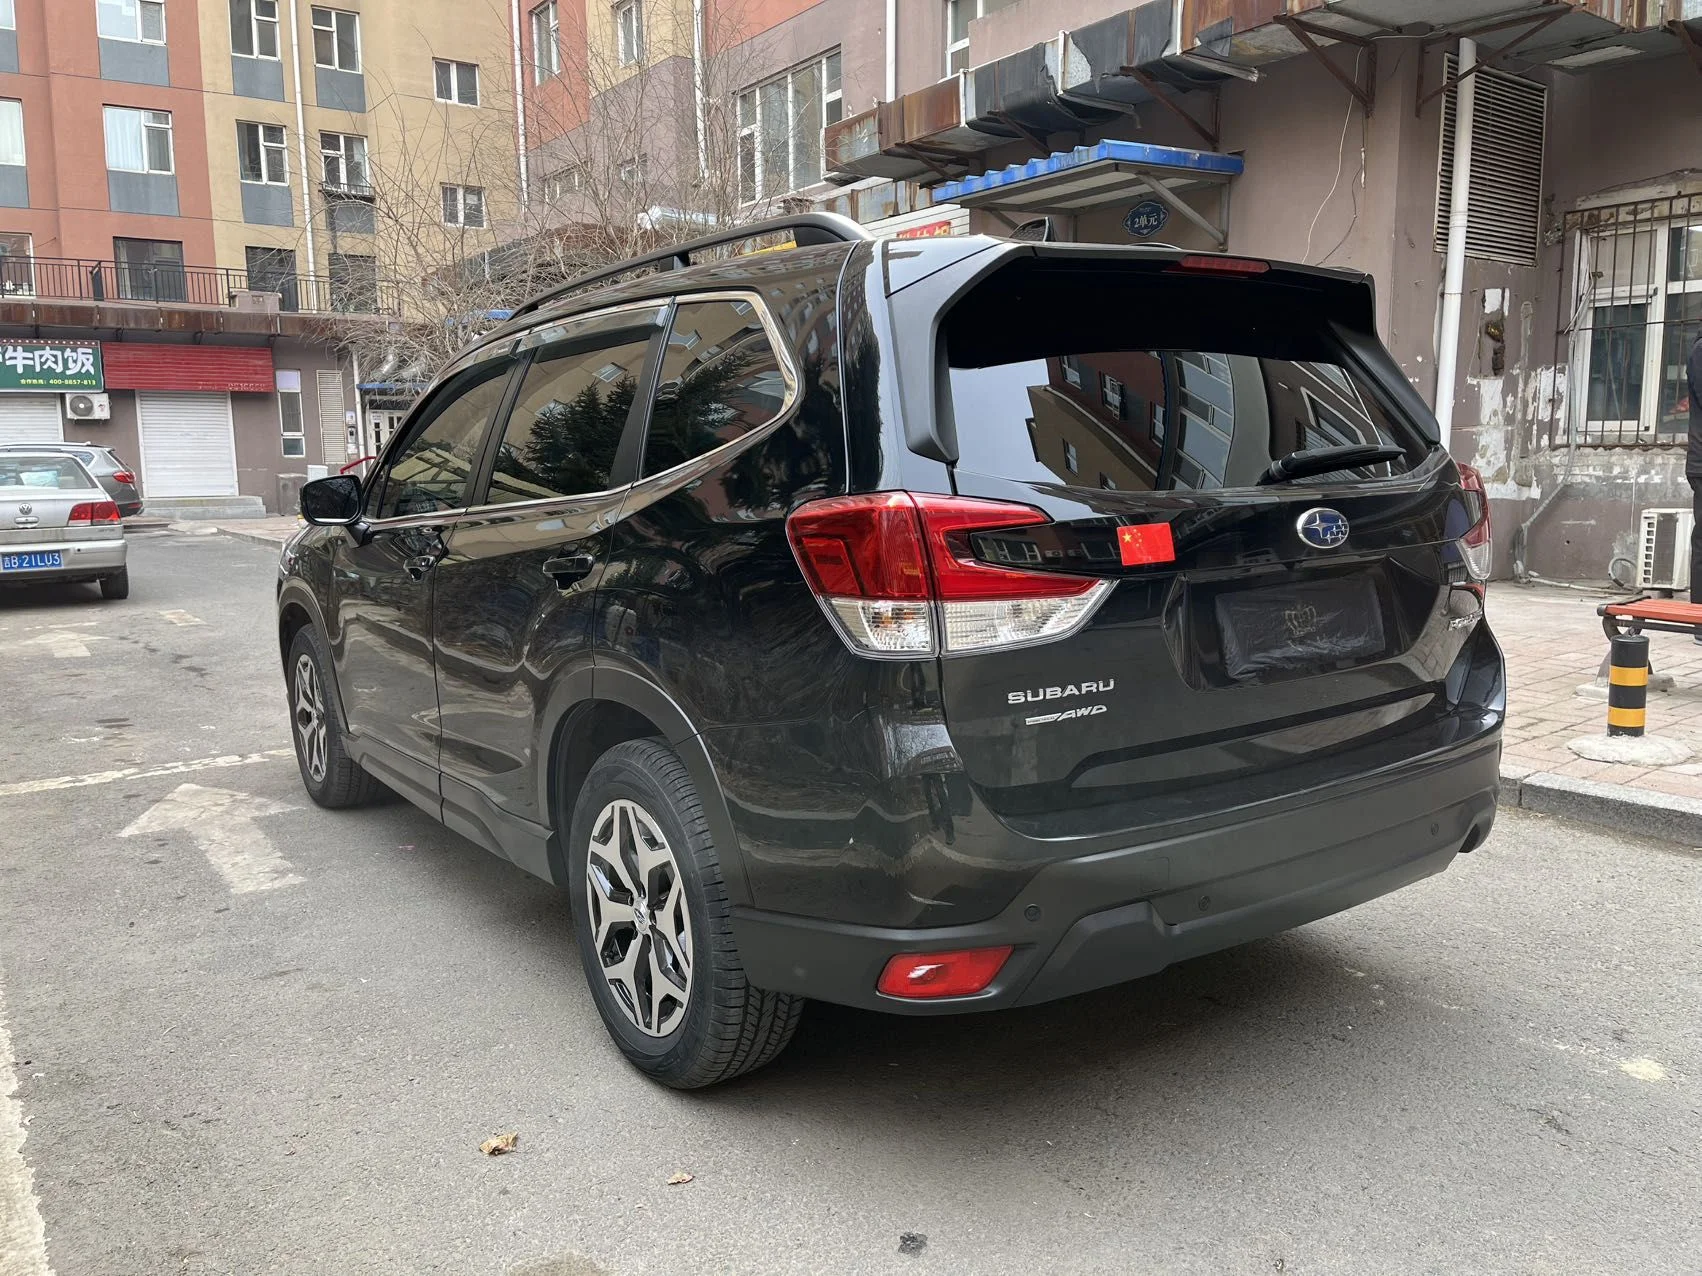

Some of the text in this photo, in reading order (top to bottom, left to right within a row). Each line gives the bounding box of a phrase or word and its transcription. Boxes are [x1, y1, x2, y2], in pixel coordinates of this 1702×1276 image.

[1134, 213, 1158, 228] 2单元
[0, 345, 95, 376] 牛肉饭
[1007, 678, 1115, 704] SUBARU
[1057, 704, 1108, 722] AWD
